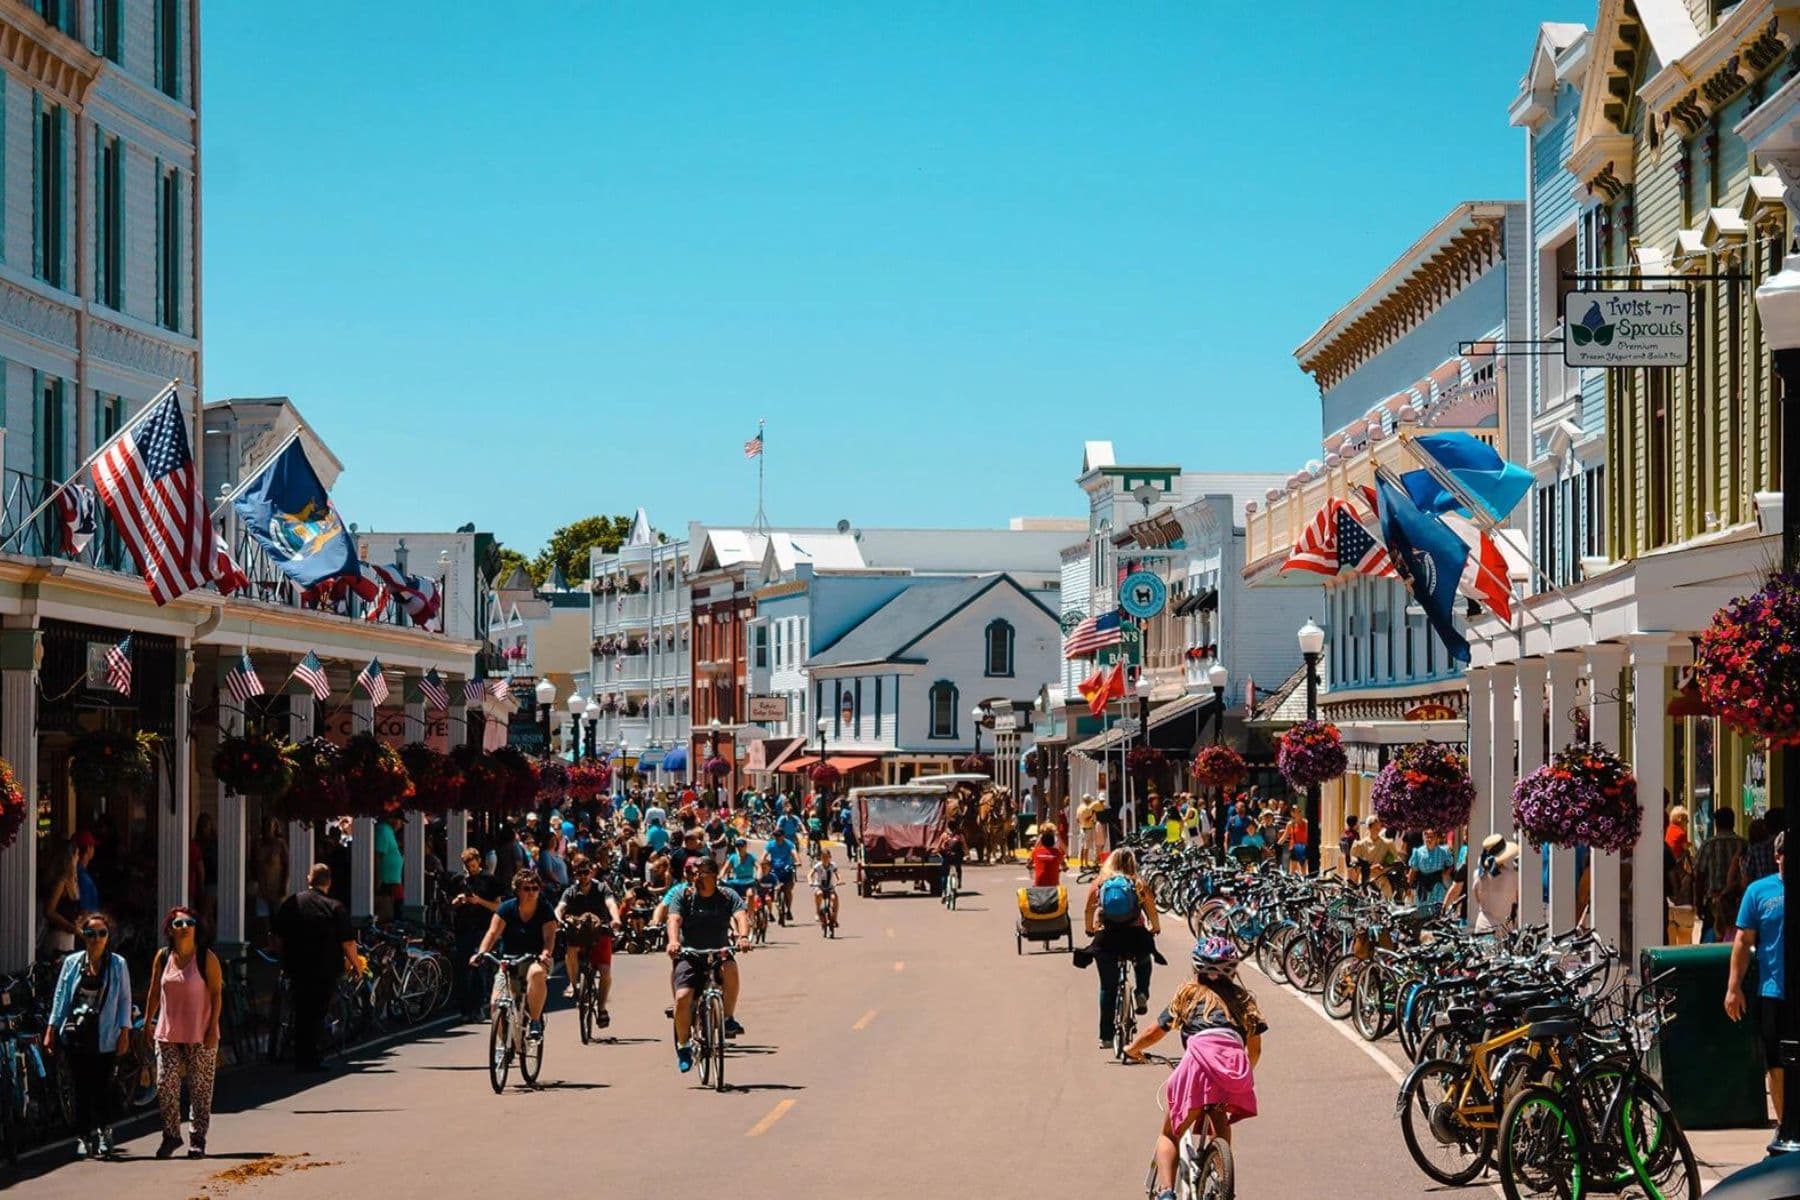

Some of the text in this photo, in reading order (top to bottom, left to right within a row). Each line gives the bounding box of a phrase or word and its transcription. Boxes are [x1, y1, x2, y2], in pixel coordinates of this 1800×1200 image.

[1606, 296, 1652, 316] Twist
[1618, 318, 1684, 340] Sprouts
[1617, 341, 1658, 351] Premium
